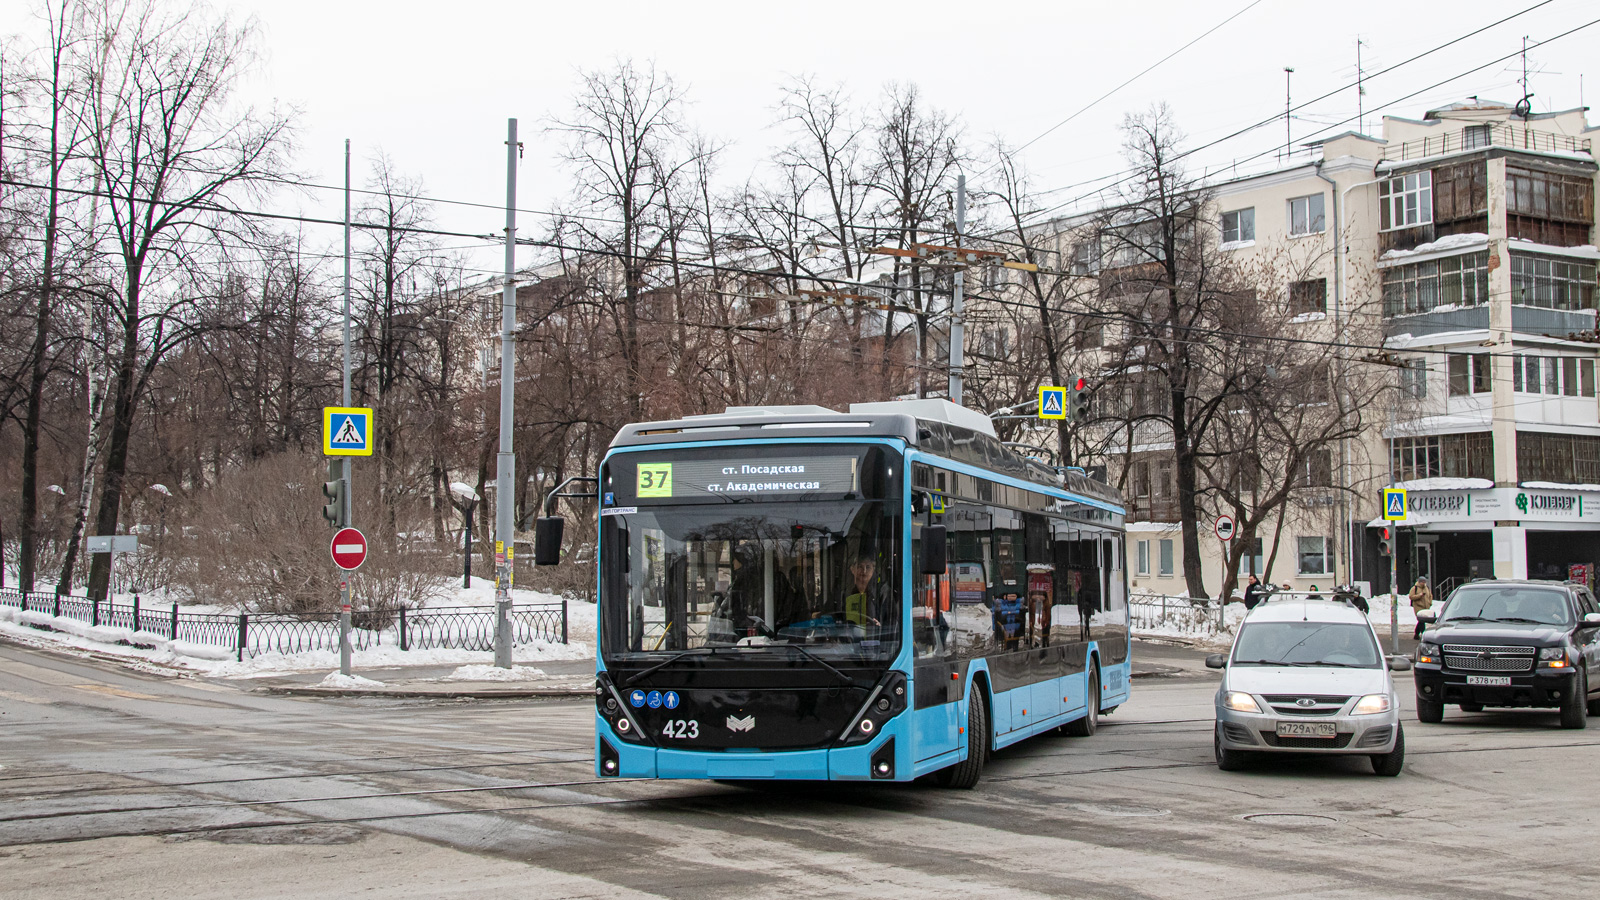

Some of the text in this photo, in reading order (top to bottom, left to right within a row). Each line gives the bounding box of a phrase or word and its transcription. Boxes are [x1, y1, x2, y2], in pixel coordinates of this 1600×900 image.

[722, 465, 805, 475] ст. Посадская
[640, 470, 669, 489] 37
[707, 481, 820, 492] ст. Академическая
[1408, 495, 1465, 511] КЛЕВЕР
[1530, 494, 1576, 510] КЛЕВЕР
[662, 719, 700, 739] 423
